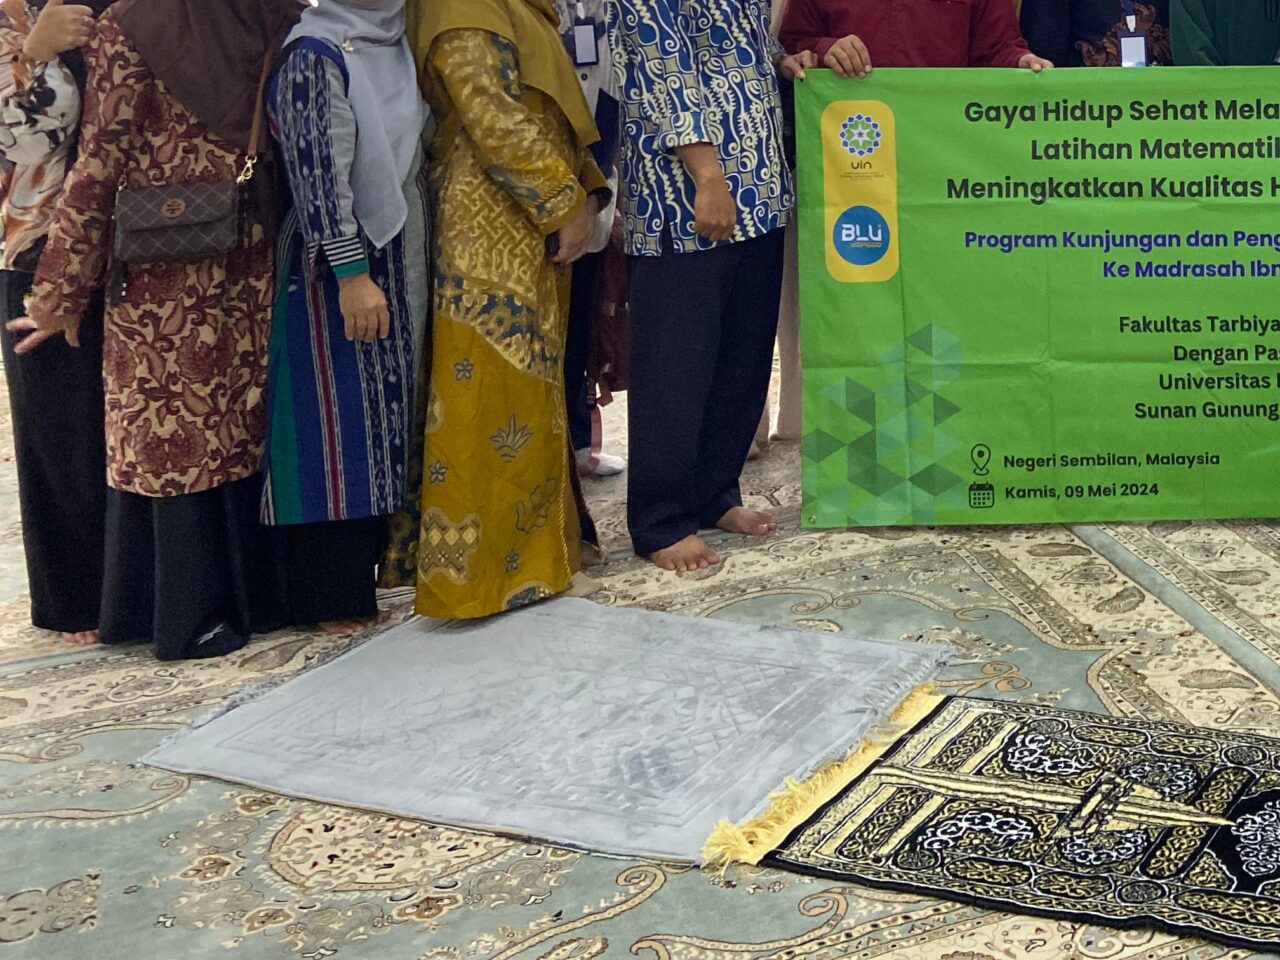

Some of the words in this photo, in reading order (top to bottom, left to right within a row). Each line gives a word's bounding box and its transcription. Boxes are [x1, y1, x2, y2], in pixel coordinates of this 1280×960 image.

[964, 101, 1036, 130] Gaya
[1043, 98, 1123, 129] Hidup
[1129, 99, 1208, 122] Sehat
[1031, 136, 1133, 161] Latihan
[946, 175, 1144, 206] Meningkatkan
[1150, 174, 1264, 198] Kualitas
[965, 230, 1058, 254] Program
[1062, 229, 1181, 254] Kunjungan
[1185, 229, 1228, 247] dan
[1103, 261, 1130, 278] Ke
[1135, 259, 1245, 278] Madrasah
[1119, 315, 1202, 333] Fakultas
[1173, 345, 1249, 366] Dengan
[1159, 371, 1271, 390] Universitas
[1134, 402, 1197, 419] Sunan
[1202, 401, 1280, 422] Gunung
[1003, 452, 1057, 471] Negeri
[1060, 451, 1143, 470] Sembilan,
[1145, 451, 1220, 468] Malaysia
[1005, 484, 1061, 501] Kamis,
[1064, 484, 1085, 498] 09
[1088, 482, 1117, 497] Mei
[1120, 482, 1160, 497] 2024
